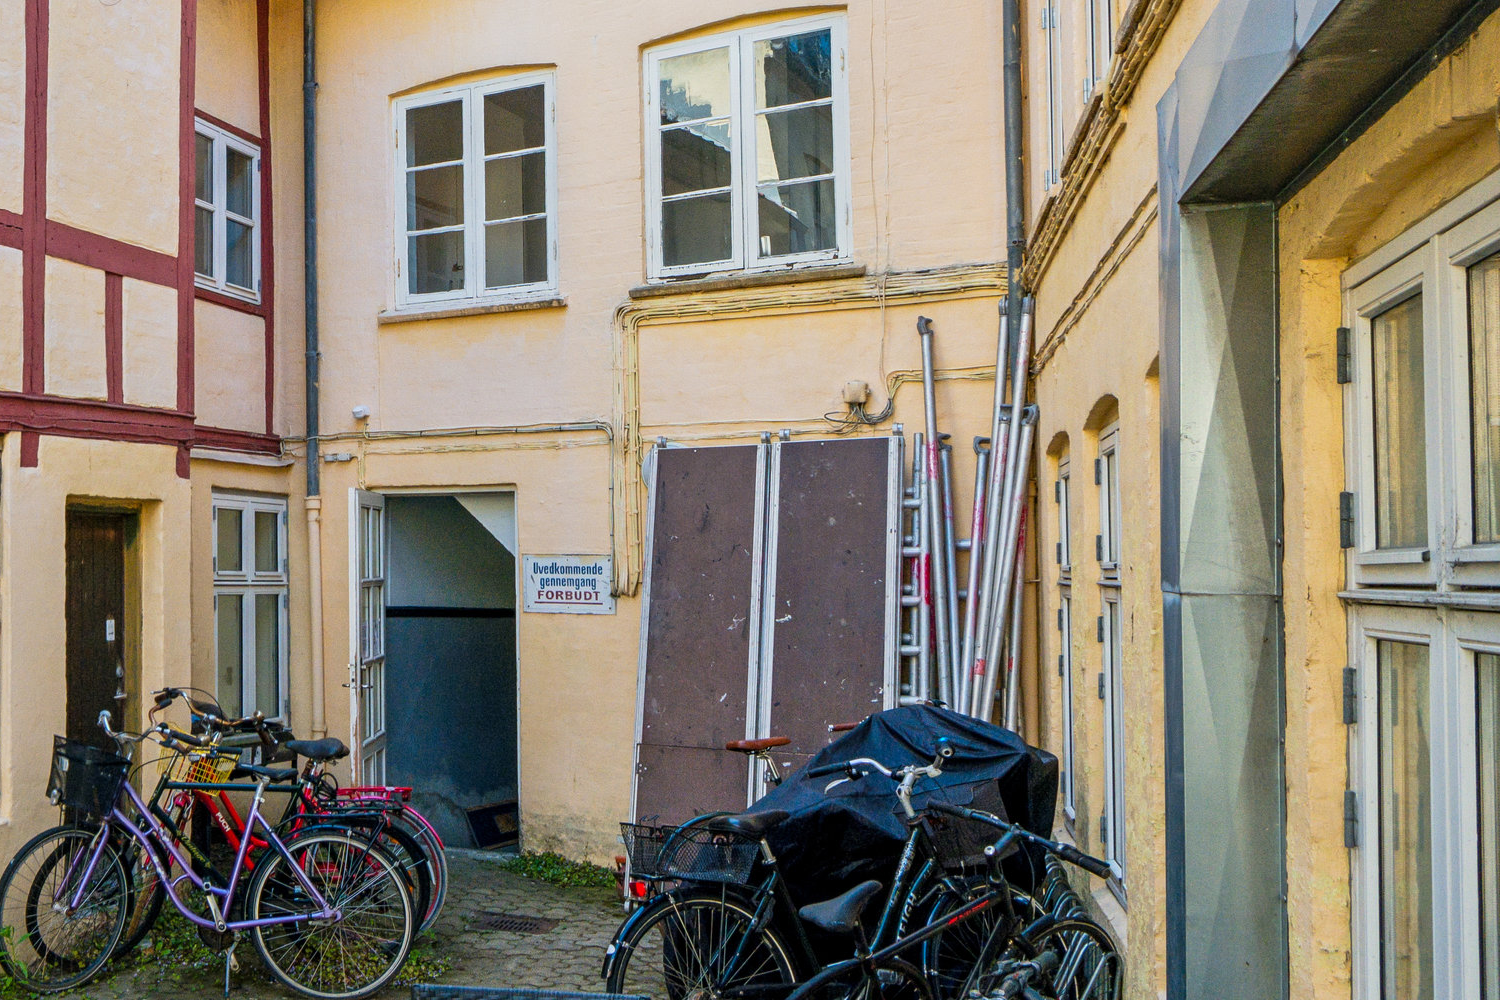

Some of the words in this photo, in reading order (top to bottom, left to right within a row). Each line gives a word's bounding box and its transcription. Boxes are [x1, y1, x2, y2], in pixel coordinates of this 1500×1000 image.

[533, 562, 603, 575] Uvedkommende
[540, 577, 596, 590] gennemgang
[538, 591, 600, 601] FORBUDT
[216, 812, 231, 832] PUCH
